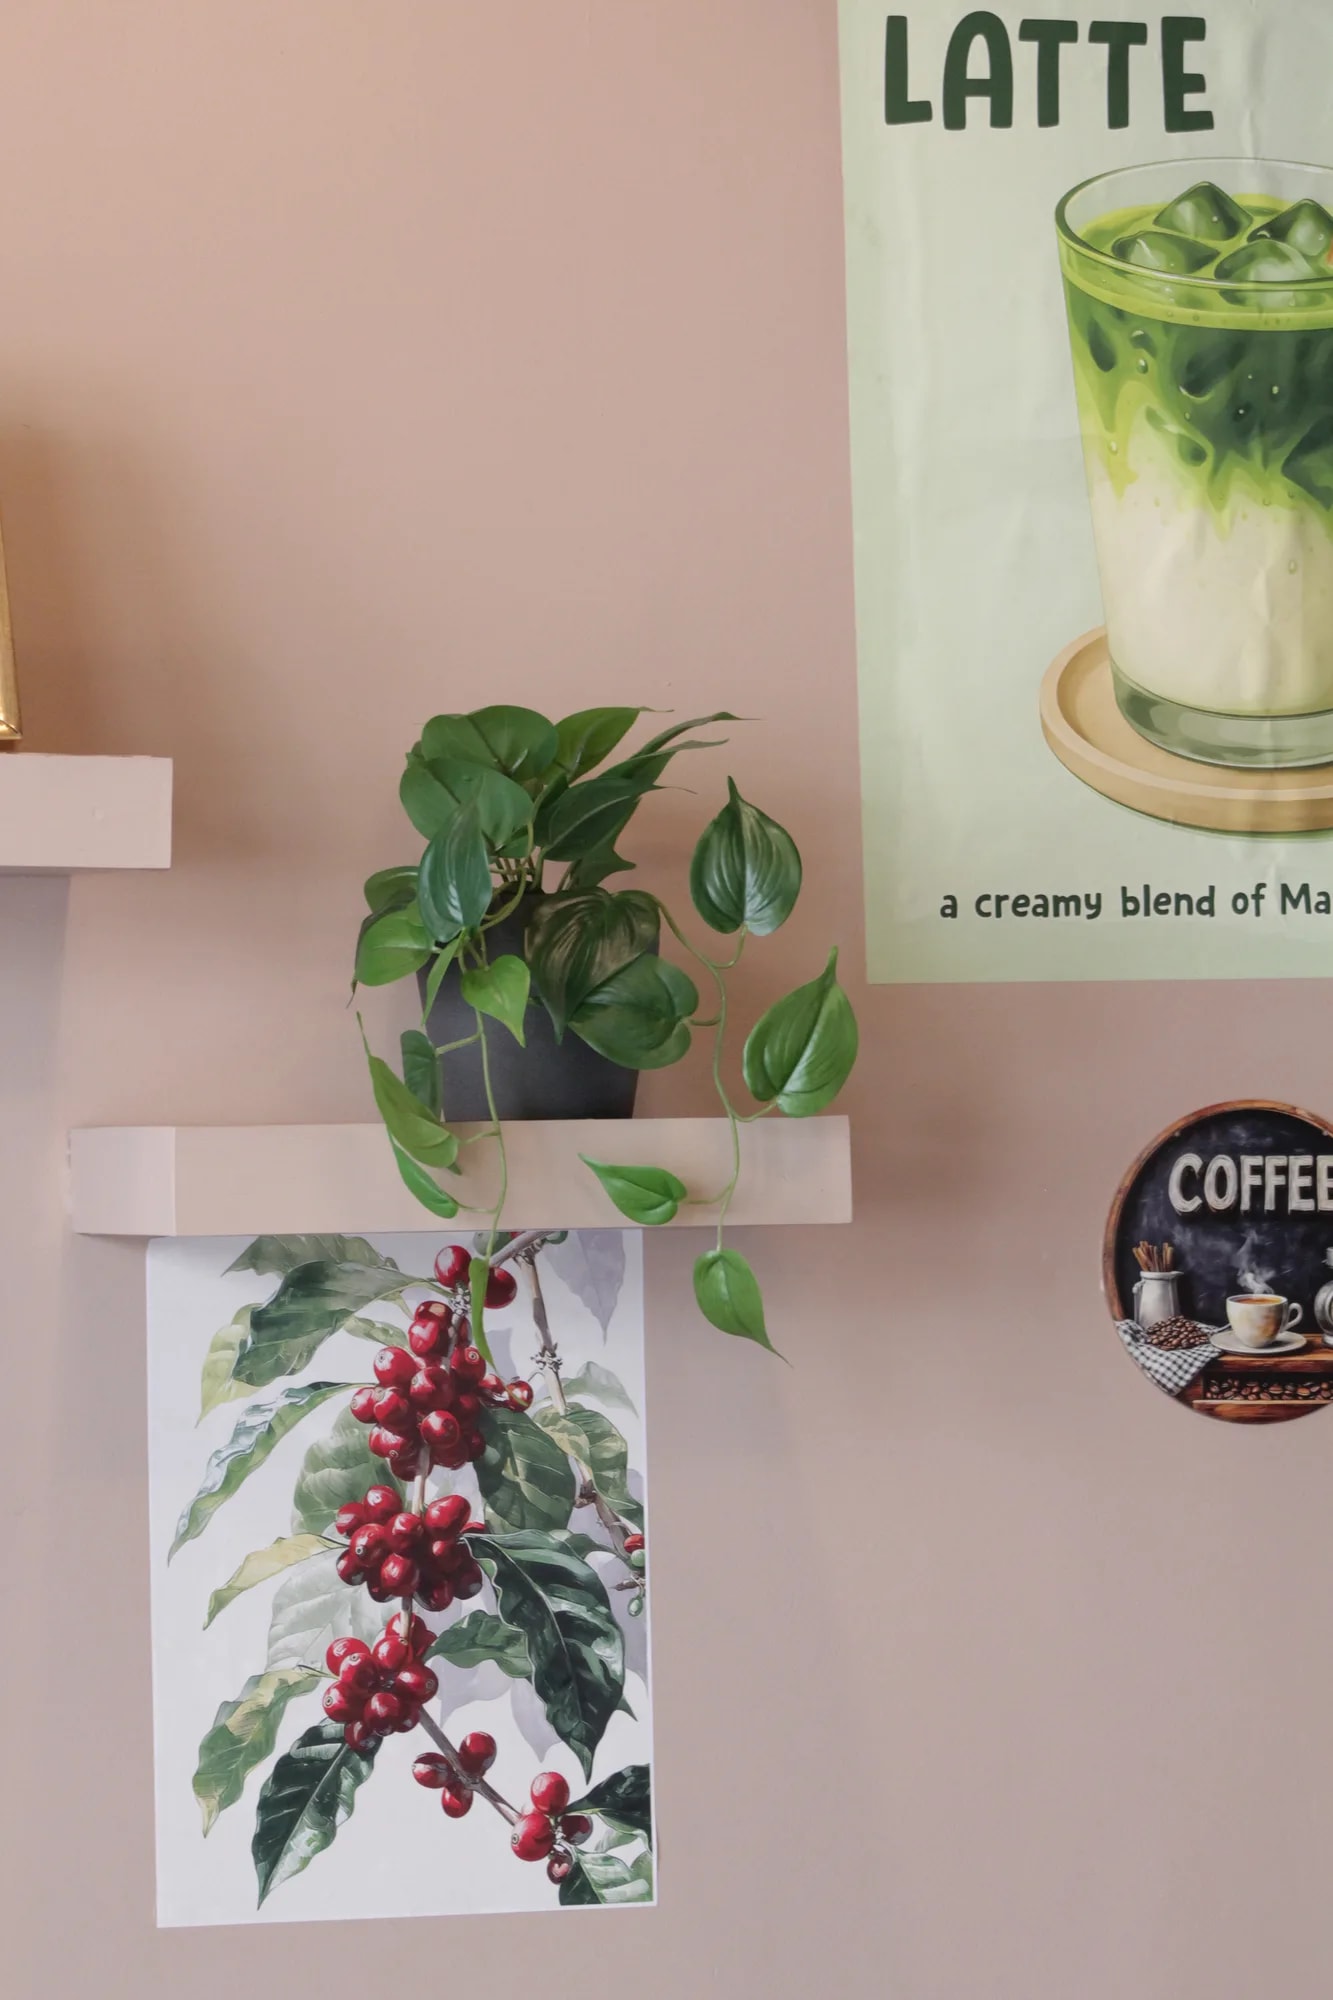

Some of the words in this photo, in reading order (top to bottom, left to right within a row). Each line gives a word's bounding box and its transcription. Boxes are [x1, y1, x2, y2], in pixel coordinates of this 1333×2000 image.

[884, 10, 1215, 133] LATTE
[939, 894, 958, 919] a
[974, 892, 1102, 920] creamy
[1120, 883, 1216, 918] blend
[1231, 882, 1267, 917] of
[1280, 882, 1332, 915] Ma
[1167, 1152, 1333, 1214] COFFEE
